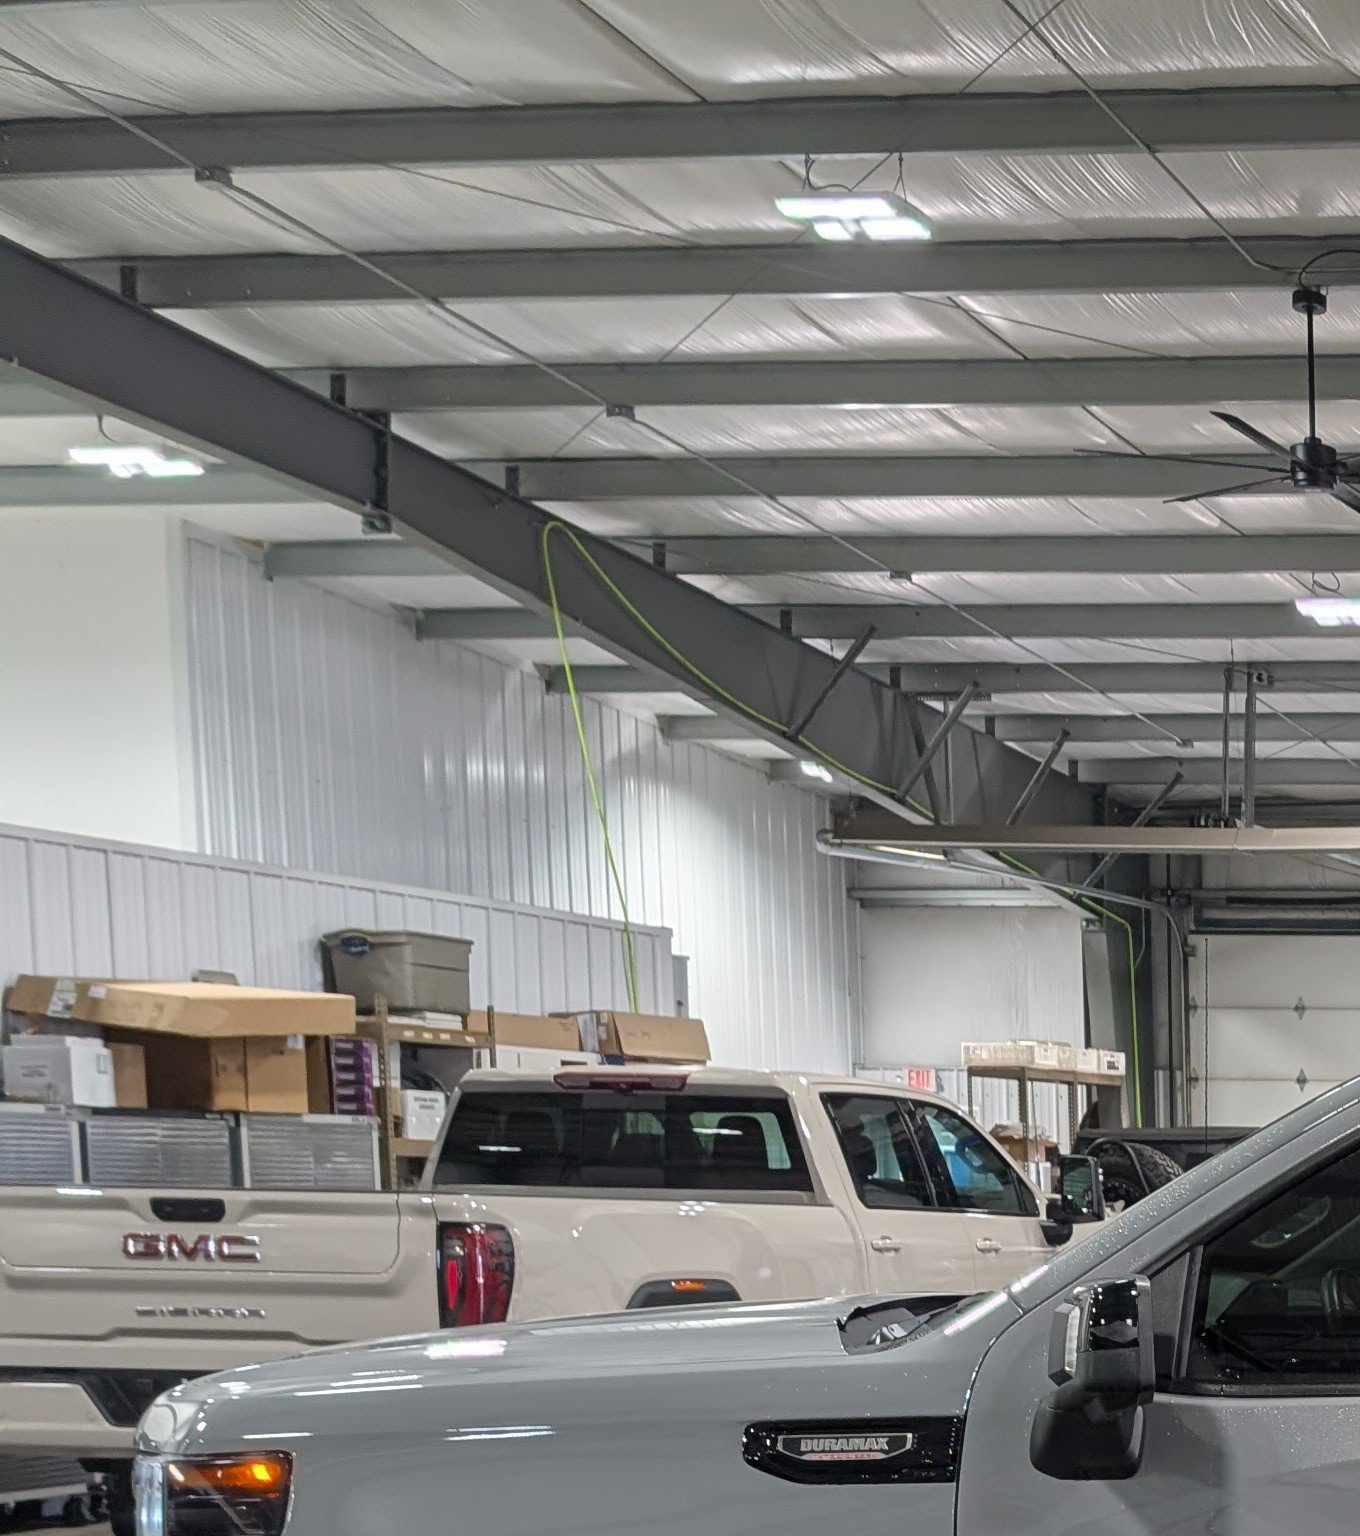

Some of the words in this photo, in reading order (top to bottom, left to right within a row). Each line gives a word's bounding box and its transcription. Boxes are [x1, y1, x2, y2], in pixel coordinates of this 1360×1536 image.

[907, 1069, 932, 1090] EXIT
[122, 1232, 262, 1262] GMC
[800, 1437, 889, 1452] DURAMAX
